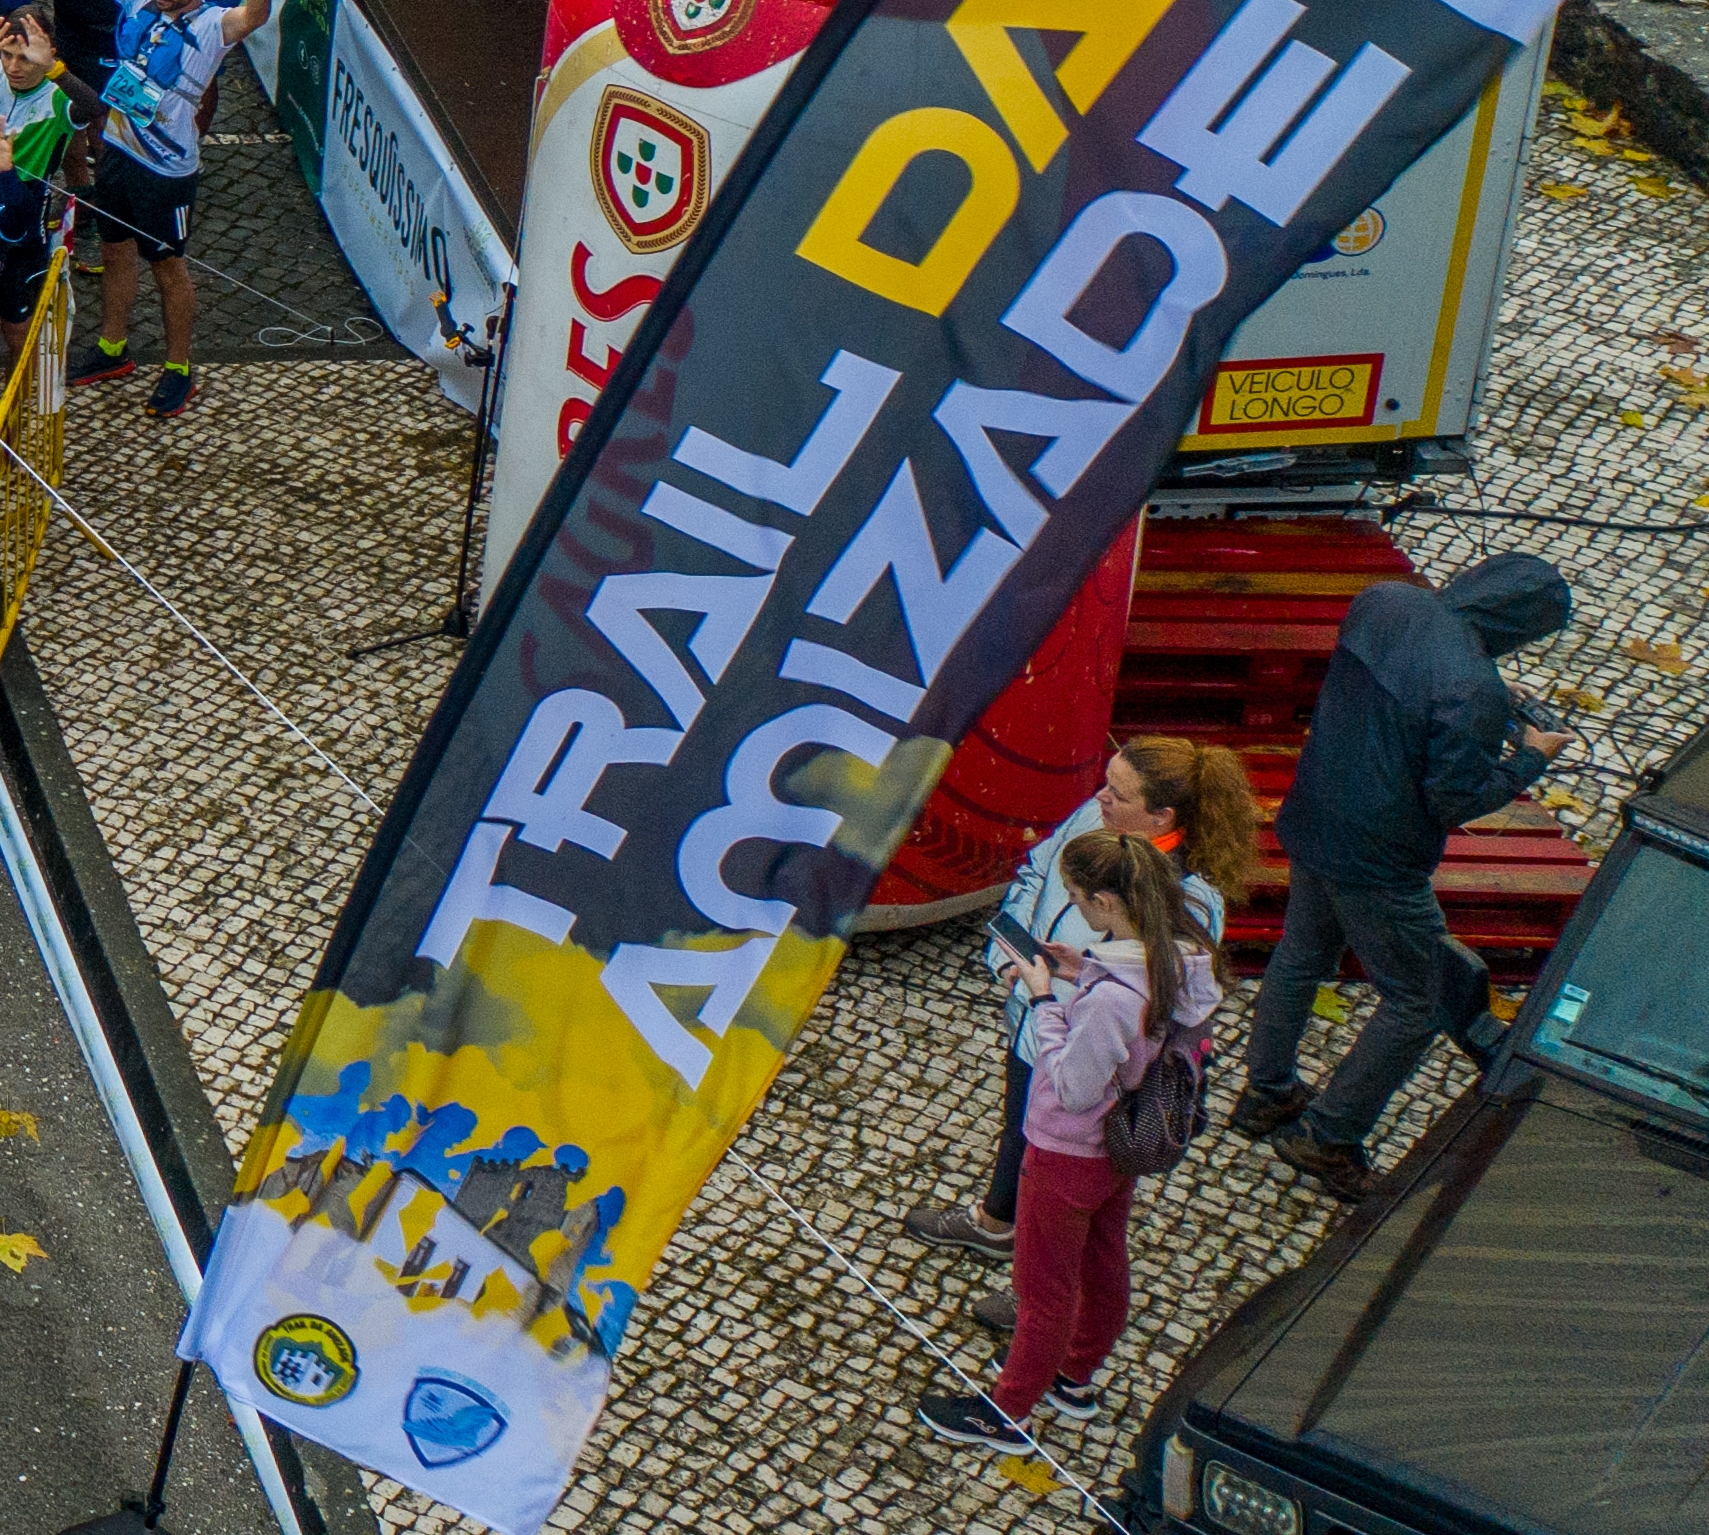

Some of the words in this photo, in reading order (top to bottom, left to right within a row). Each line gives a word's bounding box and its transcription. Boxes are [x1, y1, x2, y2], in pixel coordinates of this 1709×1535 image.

[111, 75, 135, 98] 726
[1229, 367, 1356, 396] VEICULO
[1229, 392, 1345, 422] LONGO
[416, 348, 902, 970] TRAIL
